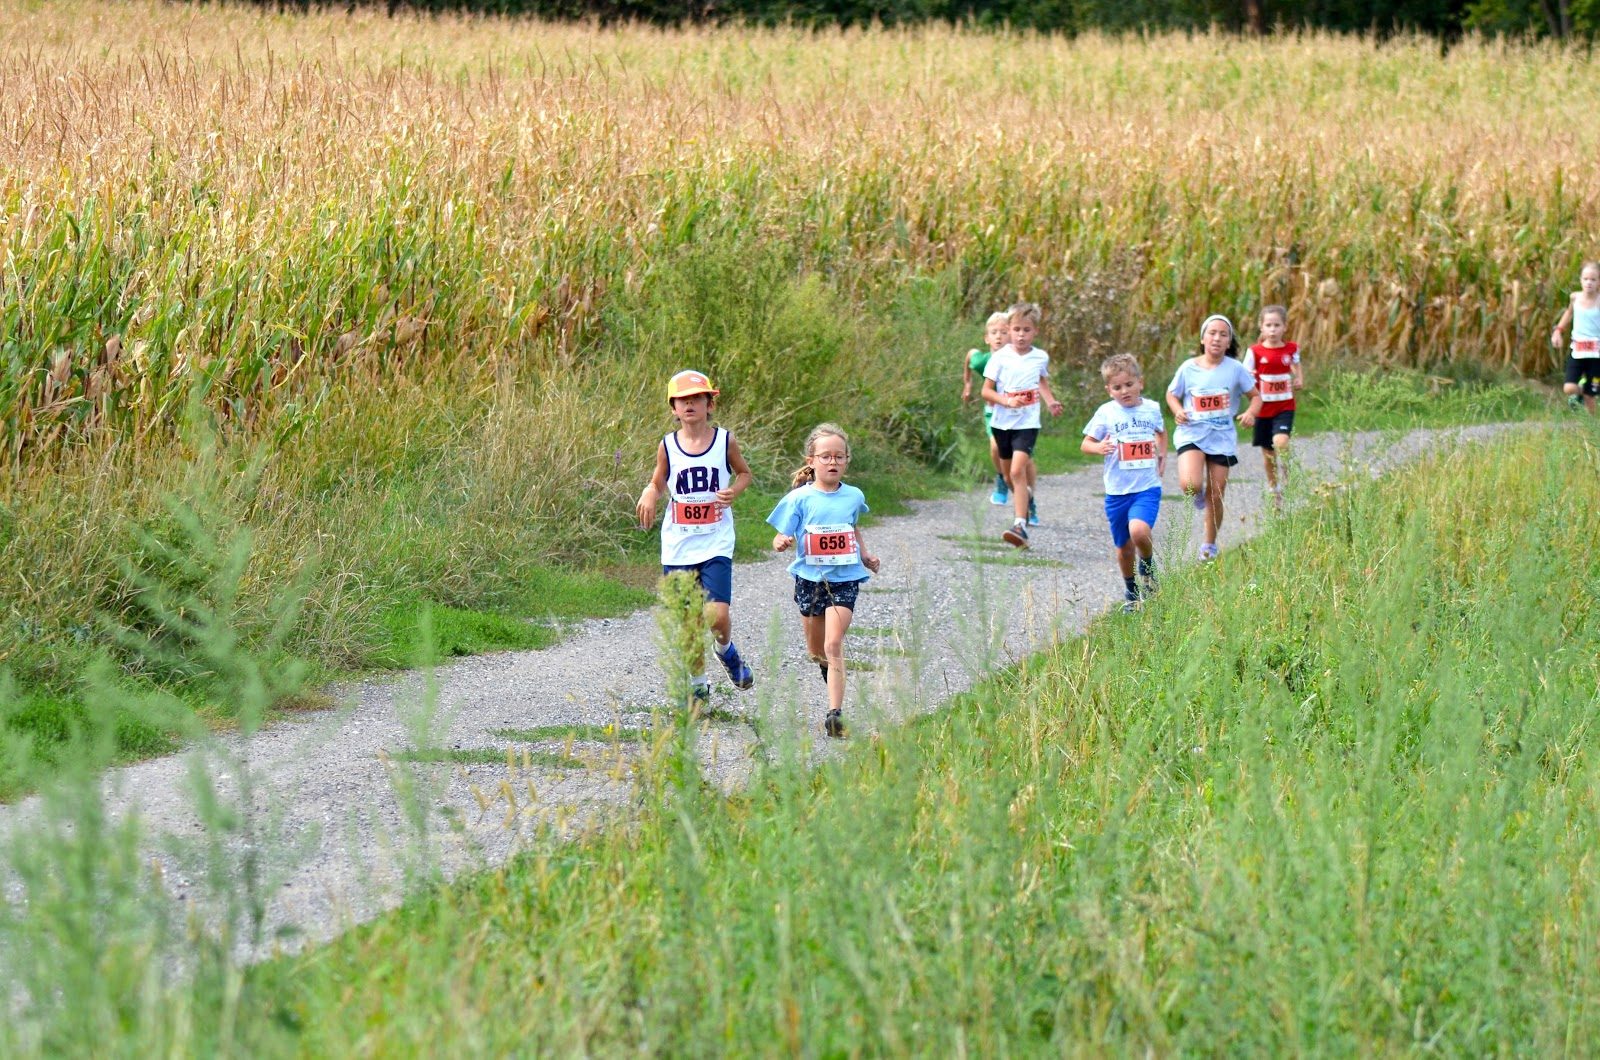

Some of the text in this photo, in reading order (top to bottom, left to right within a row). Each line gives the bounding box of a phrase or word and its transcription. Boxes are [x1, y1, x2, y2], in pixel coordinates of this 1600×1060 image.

[1200, 397, 1220, 408] 676
[1115, 422, 1129, 433] Los
[1130, 443, 1150, 456] 718
[676, 466, 720, 495] NBA
[684, 505, 710, 519] 687
[819, 535, 846, 550] 658
